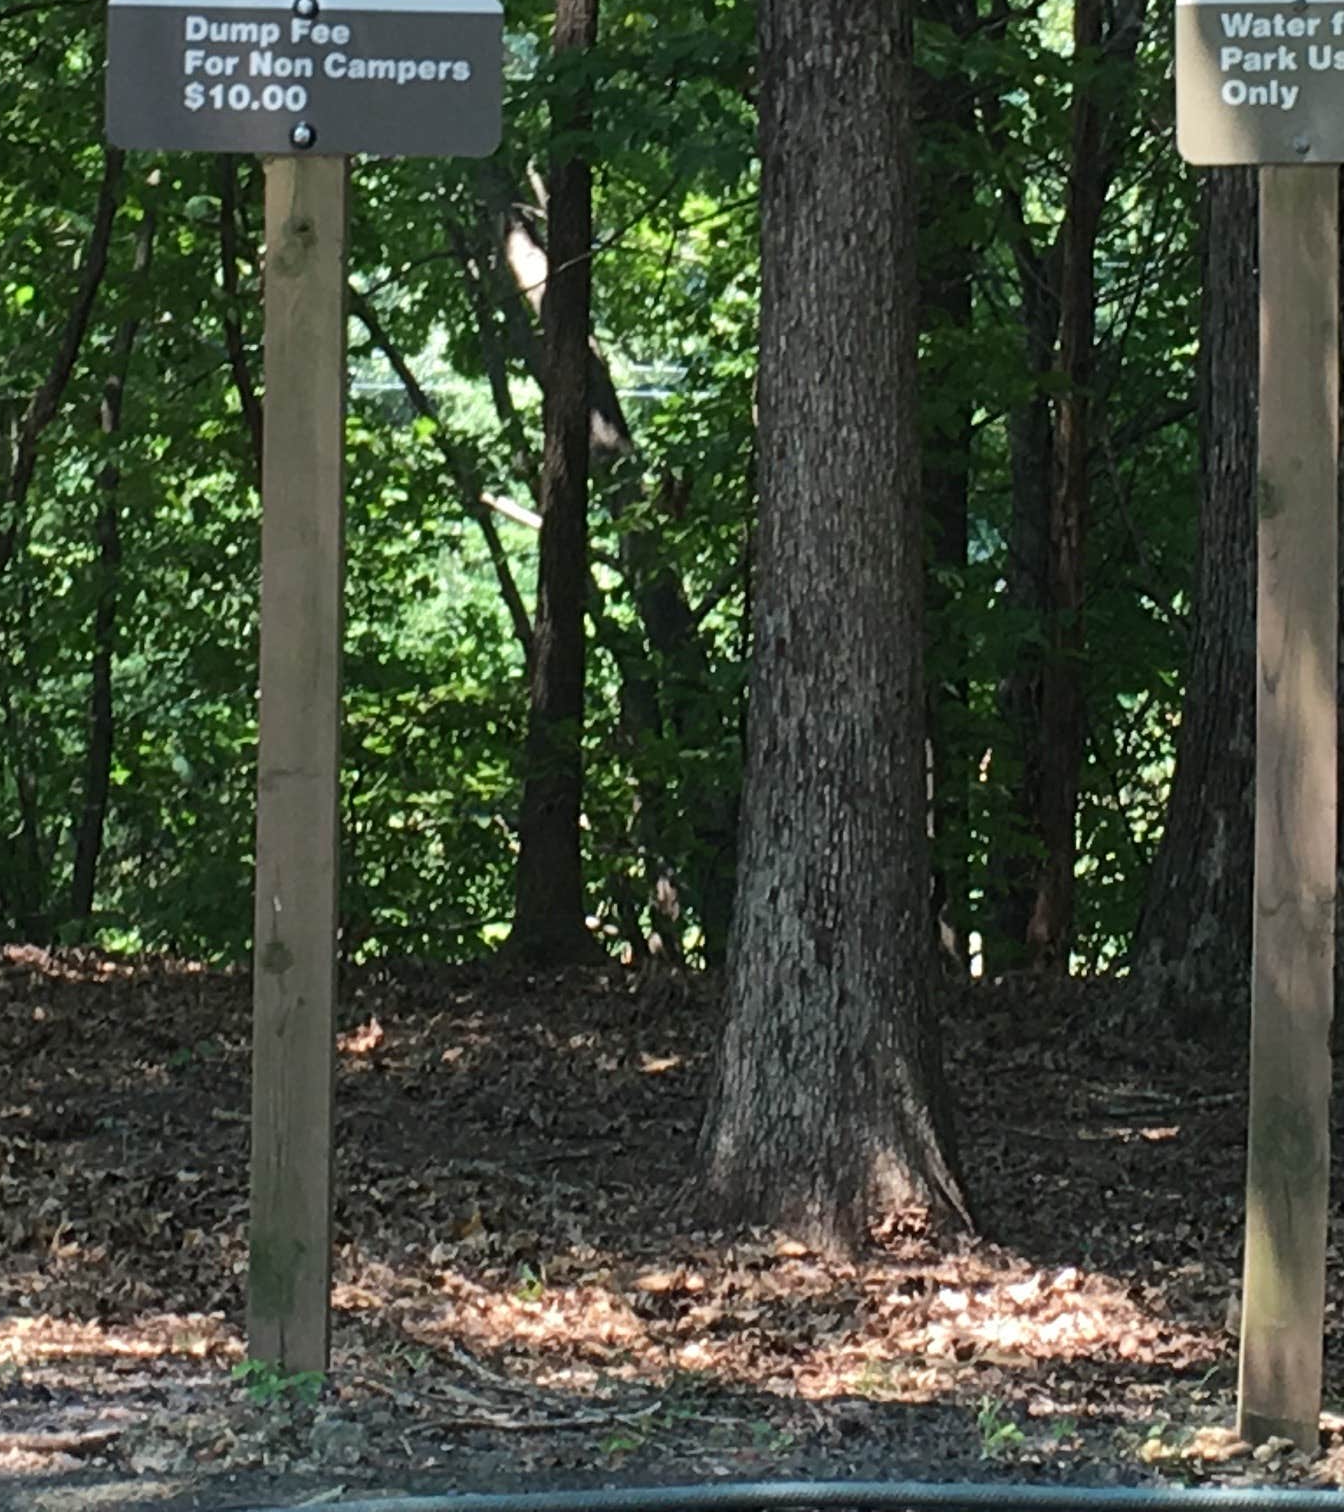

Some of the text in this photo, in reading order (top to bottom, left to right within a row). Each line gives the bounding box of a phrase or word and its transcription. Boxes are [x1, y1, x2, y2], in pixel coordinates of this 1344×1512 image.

[186, 17, 350, 50] Dump Fee
[1221, 12, 1320, 38] Water
[185, 50, 471, 87] For Non Campers
[1221, 46, 1298, 72] Park
[184, 83, 307, 113] $10.00
[1222, 80, 1299, 110] Only
